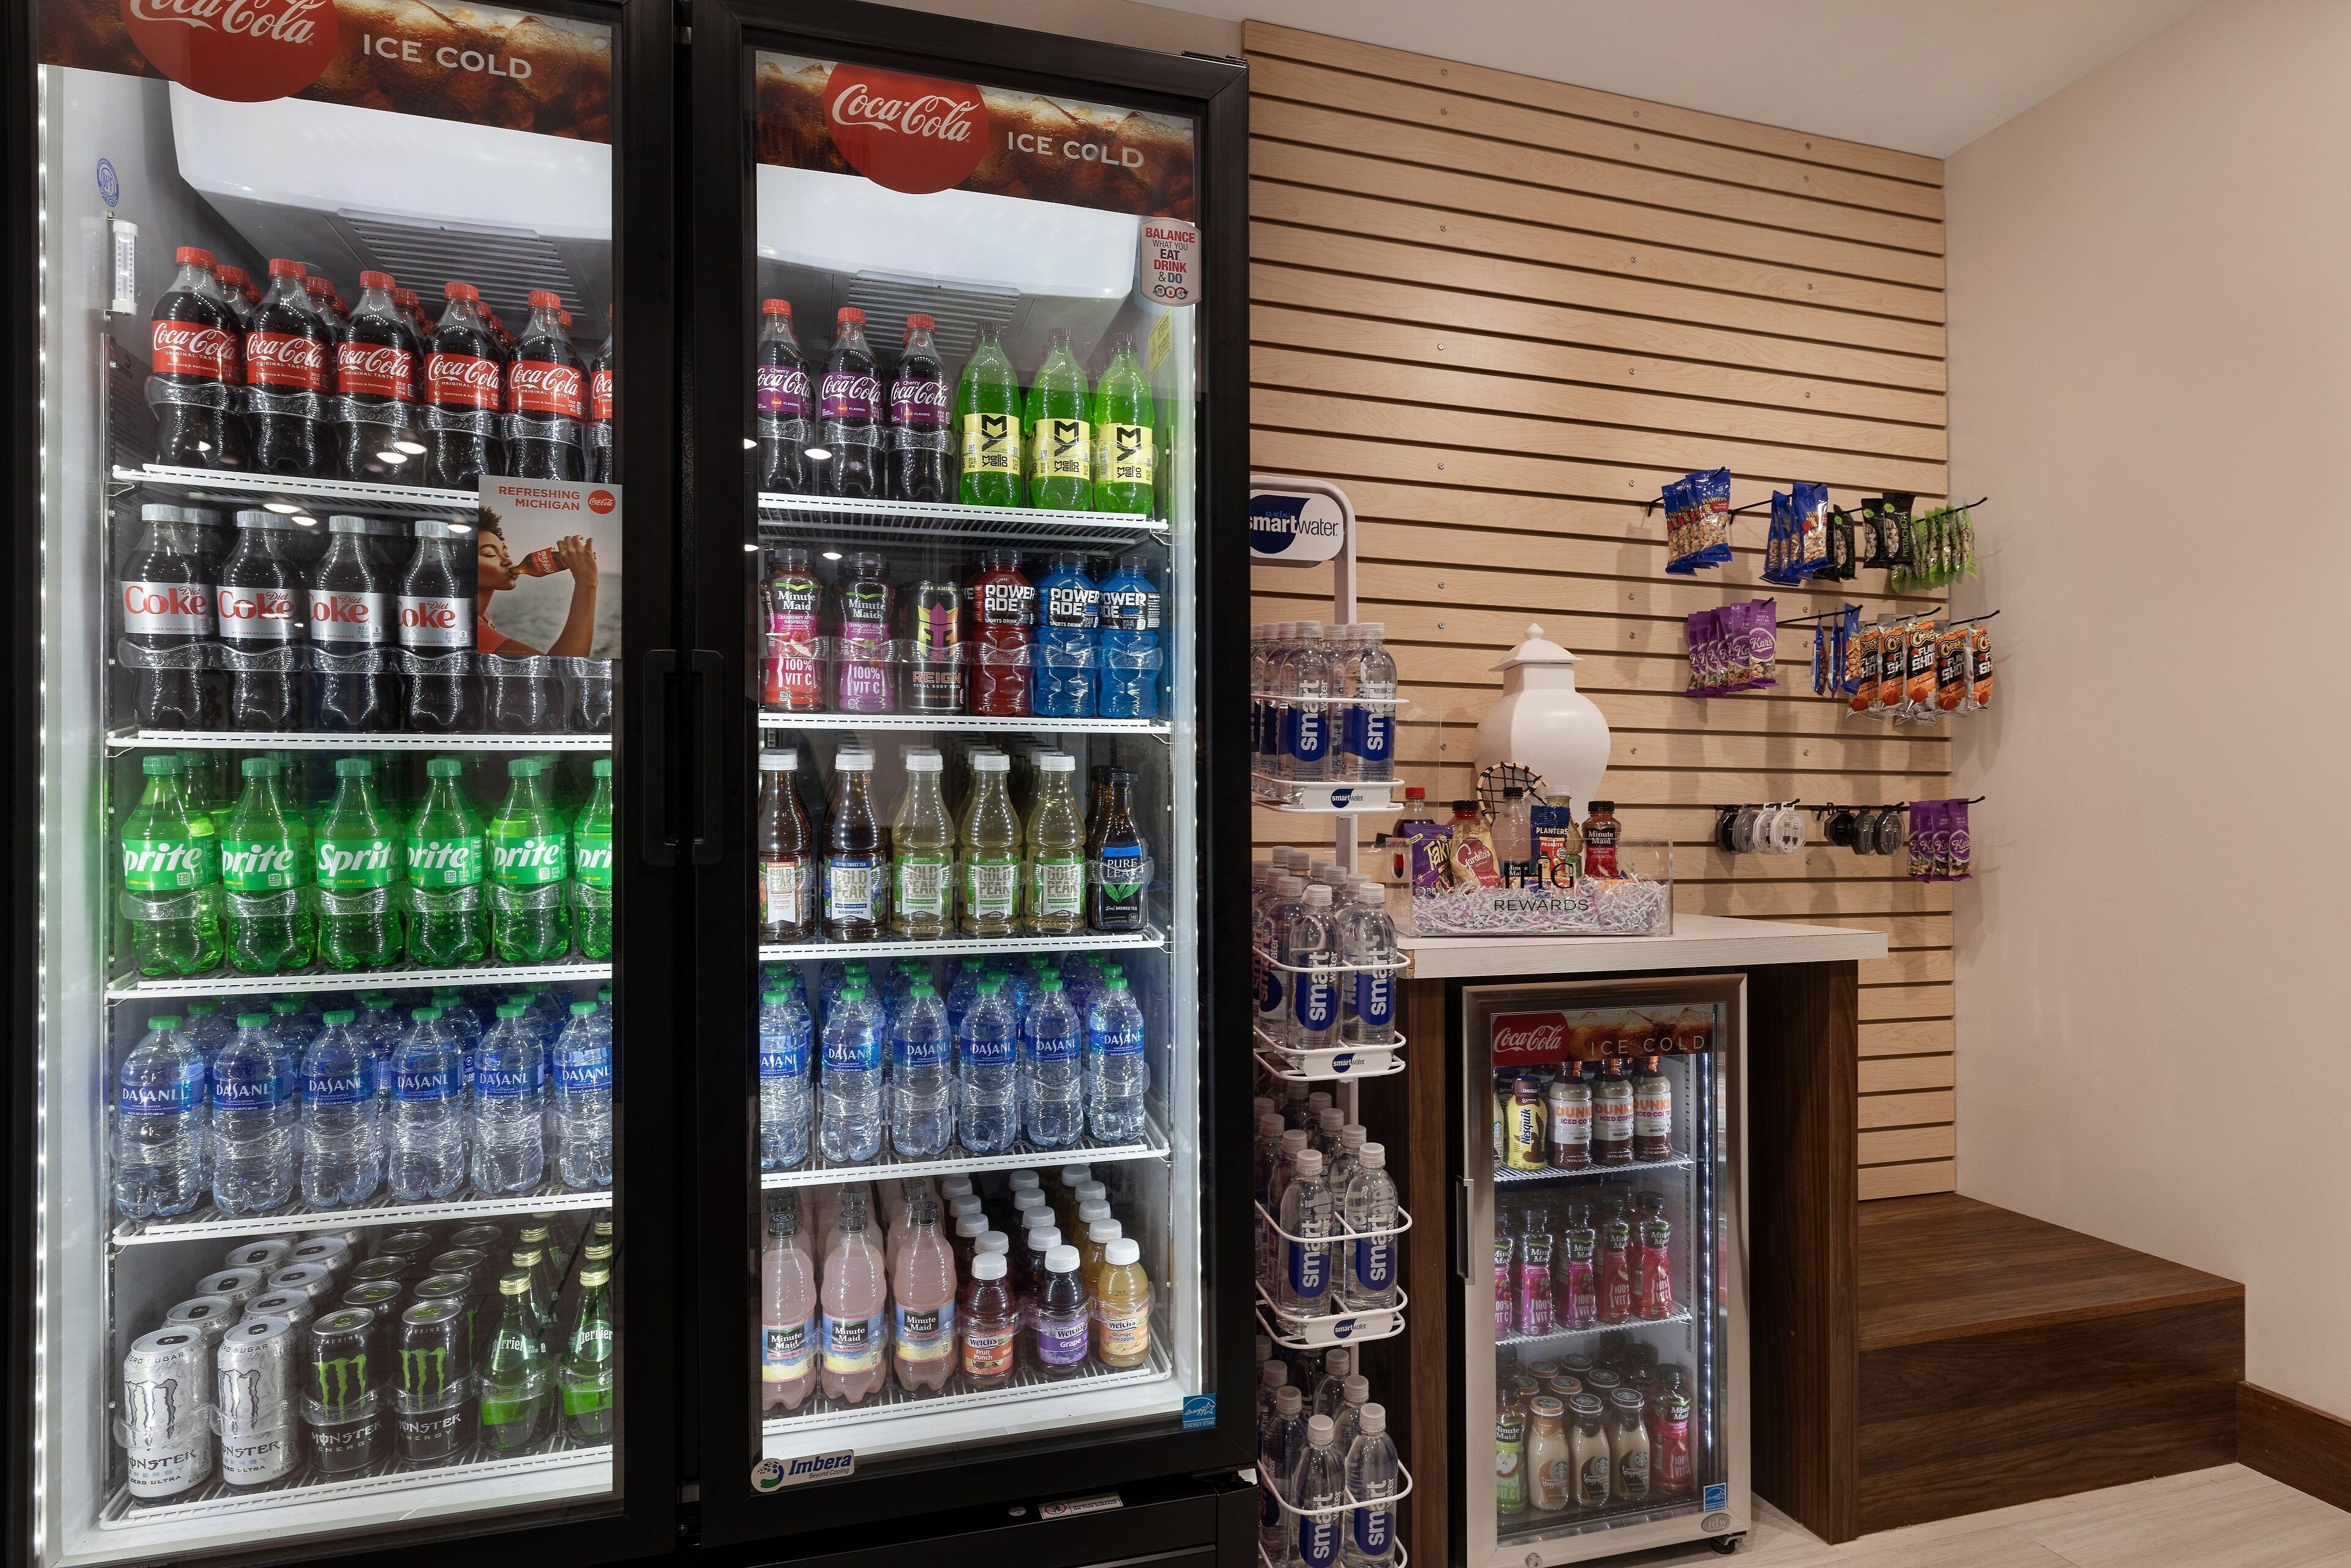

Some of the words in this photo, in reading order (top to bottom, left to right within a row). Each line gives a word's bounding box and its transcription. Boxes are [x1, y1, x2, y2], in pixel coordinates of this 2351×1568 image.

[364, 34, 423, 62] ICE
[435, 46, 533, 80] COLD
[832, 84, 980, 142] Coca-Cola
[1008, 132, 1052, 156] ICE
[1063, 141, 1144, 168] COLD
[1146, 227, 1194, 243] BALANCE
[1153, 239, 1172, 249] WHAT
[1175, 241, 1188, 250] YOU
[1160, 249, 1180, 262] EAT,
[1154, 260, 1187, 273] DRINK
[1158, 272, 1166, 282] &
[1168, 273, 1182, 283] DO
[153, 323, 236, 360] Coca-Cola
[247, 333, 324, 368] Coca-Cola
[339, 344, 411, 377] Coca-Cola
[429, 354, 499, 389] Coca-Cola
[510, 363, 580, 396] Coca-Cola
[822, 375, 882, 402] Coca-Cola
[891, 381, 948, 407] Coca-Cola
[498, 486, 580, 500] REFRESHING
[515, 498, 579, 511] MICHIGAN
[589, 497, 613, 506] Coca-Cola
[178, 586, 201, 595] Diet
[266, 591, 288, 600] Diet
[778, 591, 816, 602] Minute
[985, 584, 1035, 599] POWER
[1051, 588, 1099, 603] POWER
[126, 585, 207, 615] Coke
[219, 590, 294, 620] Coke
[339, 595, 362, 604] Diet
[427, 601, 449, 609] Diet
[782, 599, 812, 610] Maid
[849, 599, 885, 610] Minute
[985, 598, 1018, 611] ADE
[853, 609, 881, 618] Maid
[1050, 602, 1082, 616] ADE
[1943, 640, 1964, 655] Cheeto
[785, 659, 812, 670] 100%
[785, 673, 803, 686] VIT
[804, 673, 812, 686] C
[853, 667, 880, 680] 100%
[912, 672, 961, 684] REIGN
[853, 681, 869, 694] VIT
[872, 681, 880, 694] C
[122, 842, 203, 877] prite
[221, 844, 294, 876] prite
[319, 842, 398, 877] Sprite
[407, 841, 470, 868] prite
[1108, 858, 1137, 869] PURE
[1494, 899, 1589, 911] REWARDS
[1038, 1038, 1076, 1053] DASANI
[1104, 1030, 1141, 1046] DASANI
[1493, 1024, 1565, 1052] Coca-Cola
[1591, 1040, 1628, 1056] ICE
[1644, 1035, 1704, 1051] COLD
[829, 1046, 871, 1062] DASANI
[907, 1043, 947, 1056] DASANI
[972, 1041, 1011, 1057] DASANI
[1333, 1058, 1365, 1067] smartwater
[562, 1065, 610, 1082] DASANI
[309, 1077, 362, 1095] DASANI
[398, 1074, 449, 1091] DASANI
[480, 1072, 528, 1091] DASANI
[123, 1087, 176, 1105] DASANI
[217, 1082, 268, 1100] DASANI
[1520, 1109, 1531, 1144] Nesquik
[320, 1334, 359, 1345] TAURINE
[1060, 1338, 1081, 1348] Grape
[233, 1343, 269, 1354] SUGAR
[491, 1336, 523, 1359] perrier
[128, 1355, 143, 1364] ZERO
[312, 1420, 382, 1446] MONSTER
[318, 1437, 373, 1452] ENERGY
[789, 1455, 852, 1476] Imbera
[151, 1475, 182, 1485] ULTRA
